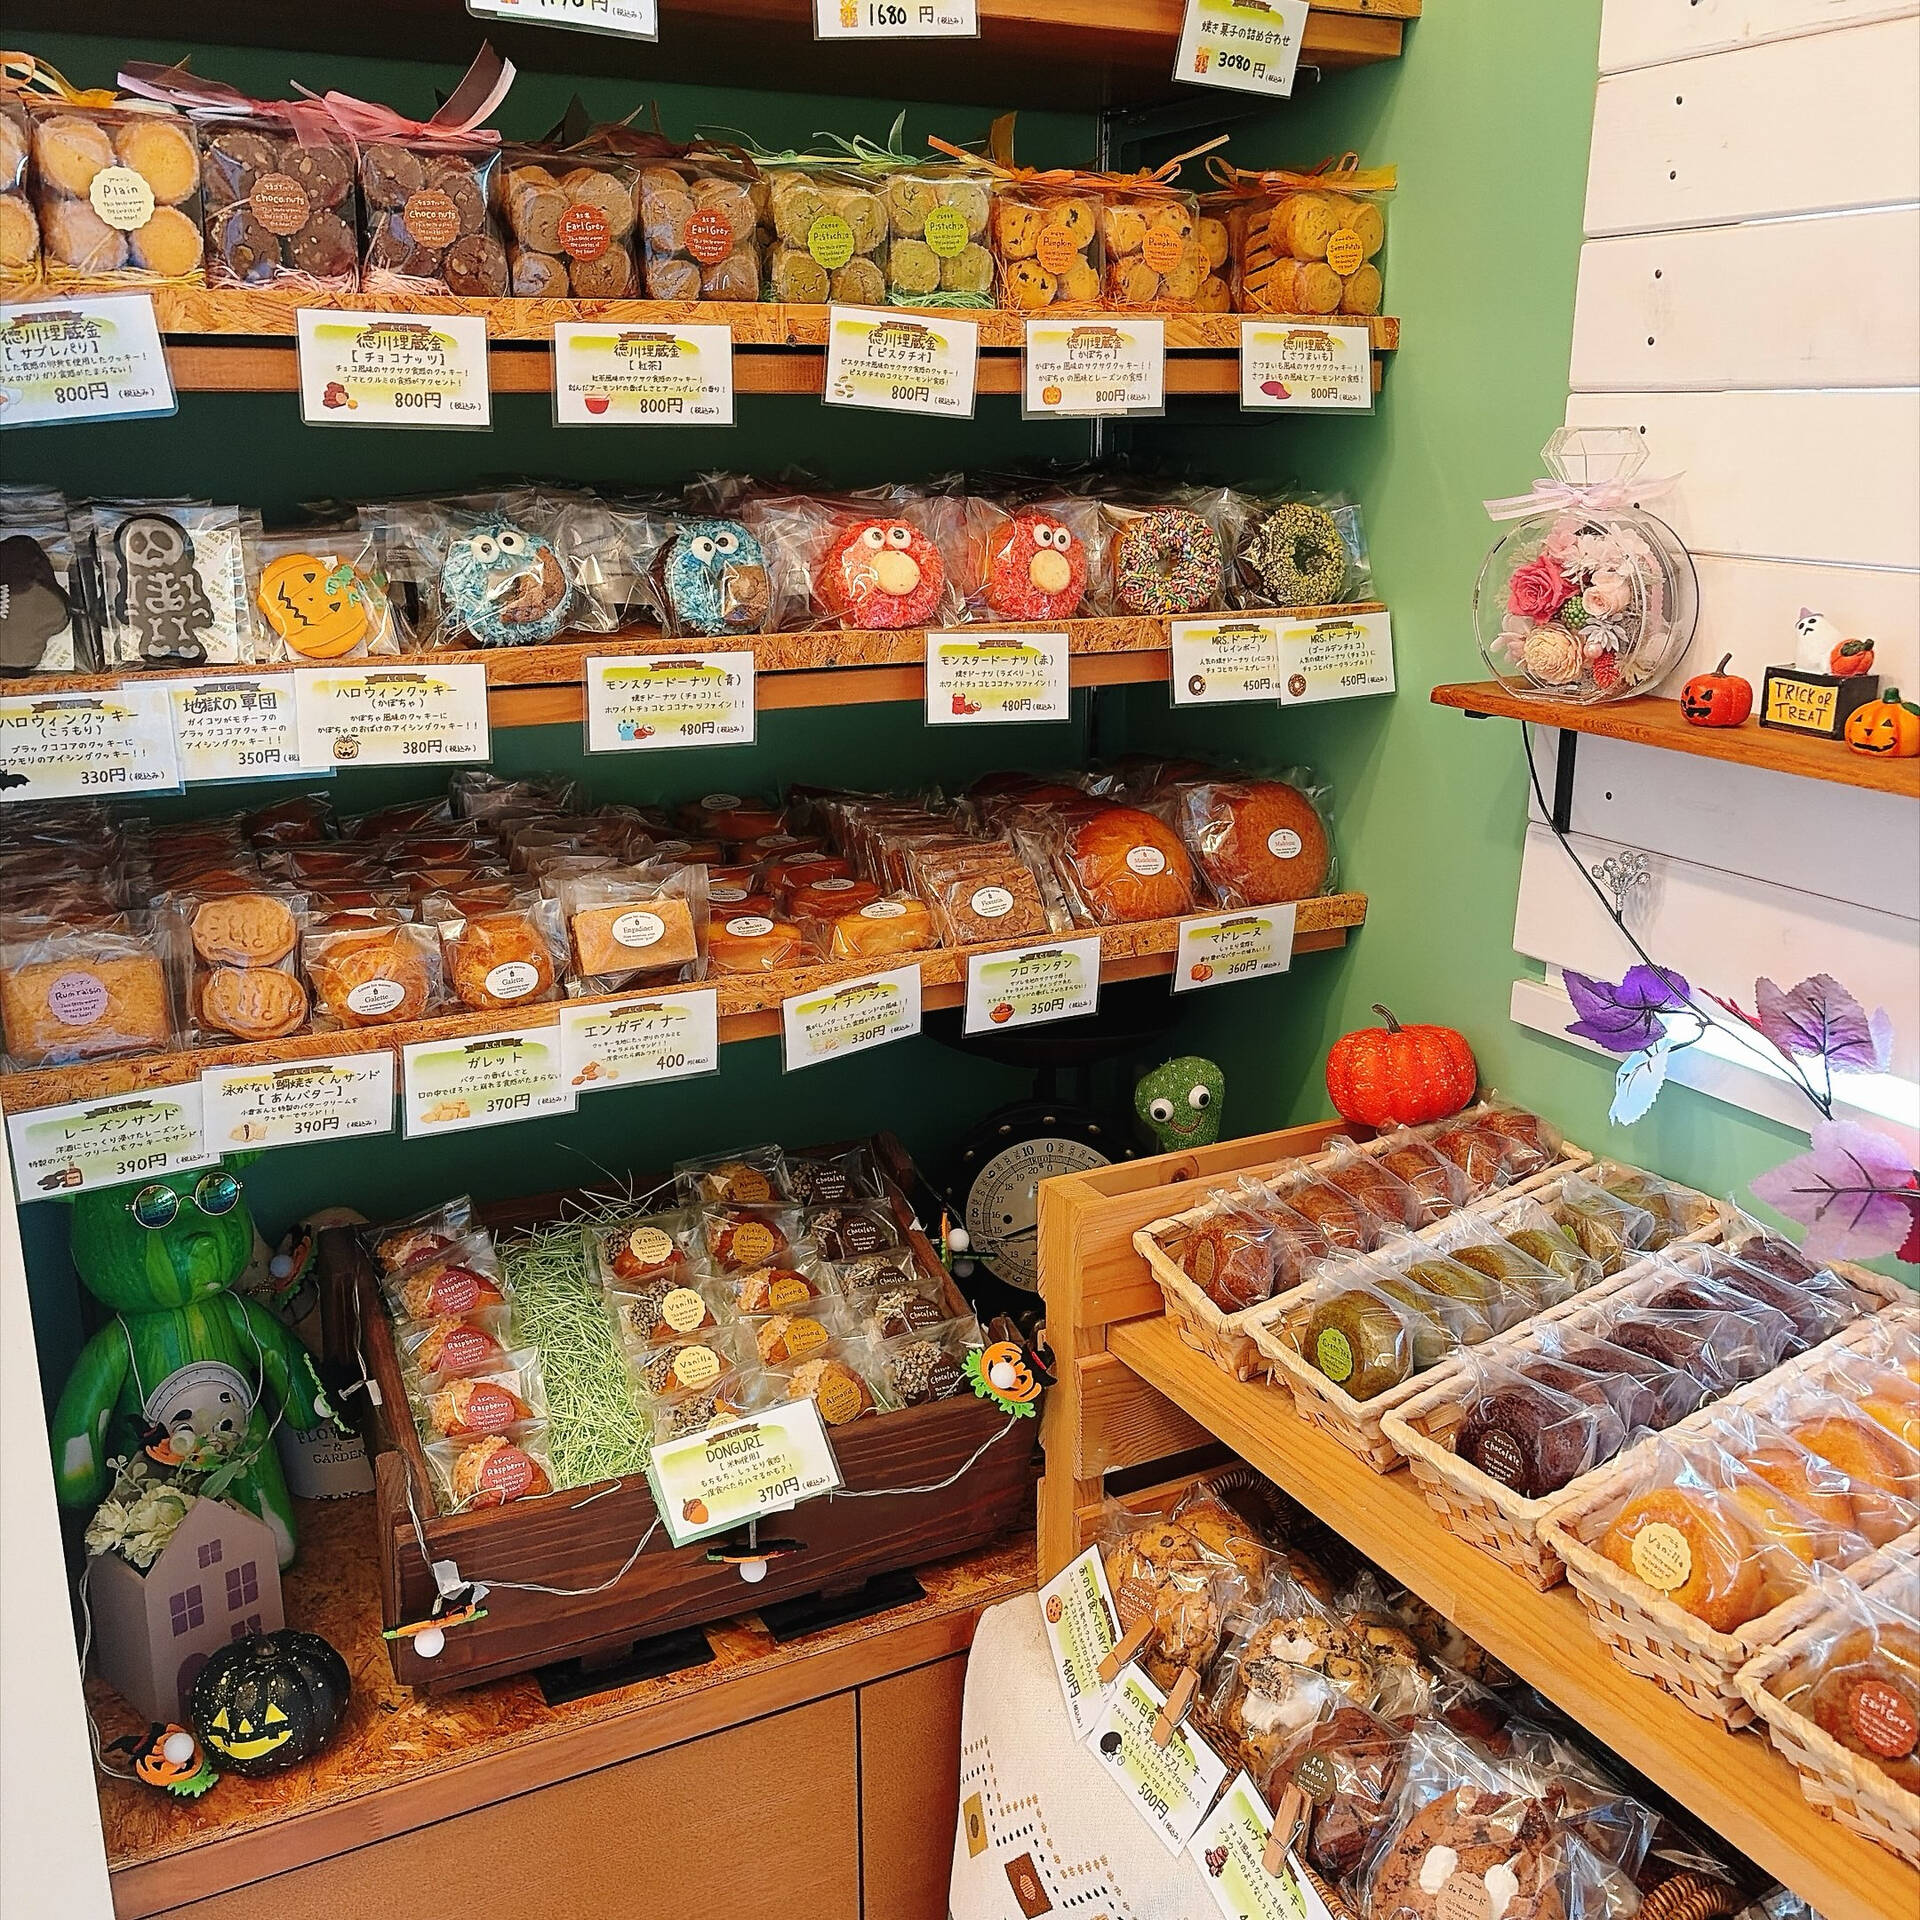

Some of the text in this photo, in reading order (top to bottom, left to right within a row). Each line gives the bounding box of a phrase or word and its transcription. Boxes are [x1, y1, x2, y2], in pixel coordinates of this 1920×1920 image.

[870, 3, 907, 25] 1680
[920, 6, 933, 23] 円
[1218, 52, 1266, 79] 3080 円
[103, 185, 138, 197] Plain
[566, 222, 604, 231] Earl Grey
[692, 225, 729, 235] Earl Grey
[356, 333, 446, 351] 徳川埋蔵金
[868, 330, 939, 351] 徳川埋蔵金
[1067, 337, 1124, 350] 徳川埋蔵金
[1283, 339, 1335, 352] 徳川埋蔵金
[614, 344, 681, 358] 徳川埋蔵金
[55, 382, 108, 404] 800円
[395, 392, 441, 408] 800円
[892, 386, 929, 402] 800円
[1096, 389, 1125, 402] 800円
[1311, 388, 1338, 399] 800円
[640, 398, 683, 413] 800円
[1244, 678, 1270, 690] 450円
[1341, 673, 1366, 686] 450円
[336, 685, 457, 698] ハロウィンクッキー
[1775, 682, 1815, 705] TRICK
[184, 692, 277, 714] 地獄の軍団
[1002, 699, 1031, 712] 480円
[1775, 703, 1826, 727] TREAT
[680, 721, 715, 735] 480円
[403, 739, 442, 754] 380円
[238, 749, 280, 765] 350円
[81, 768, 125, 784] 330円
[1211, 927, 1261, 943] マドレーヌ
[1010, 960, 1072, 978] フロランタン
[1228, 960, 1257, 975] 360円
[818, 990, 890, 1014] フィナンシェ
[1031, 998, 1064, 1014] 350円
[585, 1015, 686, 1038] エンガディナー
[851, 1025, 885, 1044] 330円
[468, 1052, 523, 1069] ガレット
[657, 1054, 684, 1070] 400
[487, 1094, 530, 1113] 370円
[65, 1108, 179, 1140] レーズンサンド
[294, 1116, 339, 1134] 390円
[1022, 1145, 1034, 1156] 10
[1046, 1143, 1053, 1152] 0
[117, 1153, 167, 1175] 390円
[972, 1209, 979, 1217] 8
[776, 1288, 802, 1300] Almond
[668, 1298, 698, 1311] Vanilla
[792, 1330, 820, 1341] Almond
[448, 1338, 482, 1350] Raspberry
[680, 1355, 711, 1368] Vanilla
[931, 1370, 959, 1384] Chocolate
[826, 1388, 853, 1406] Almond
[471, 1401, 508, 1412] Raspberry
[706, 1434, 764, 1462] DONGURI
[1484, 1440, 1520, 1466] Chocolate
[486, 1462, 525, 1476] Raspberry
[758, 1477, 799, 1503] 370円
[1649, 1533, 1684, 1568] Vanilla
[1062, 1659, 1081, 1698] 480円
[1138, 1782, 1169, 1820] 500円
